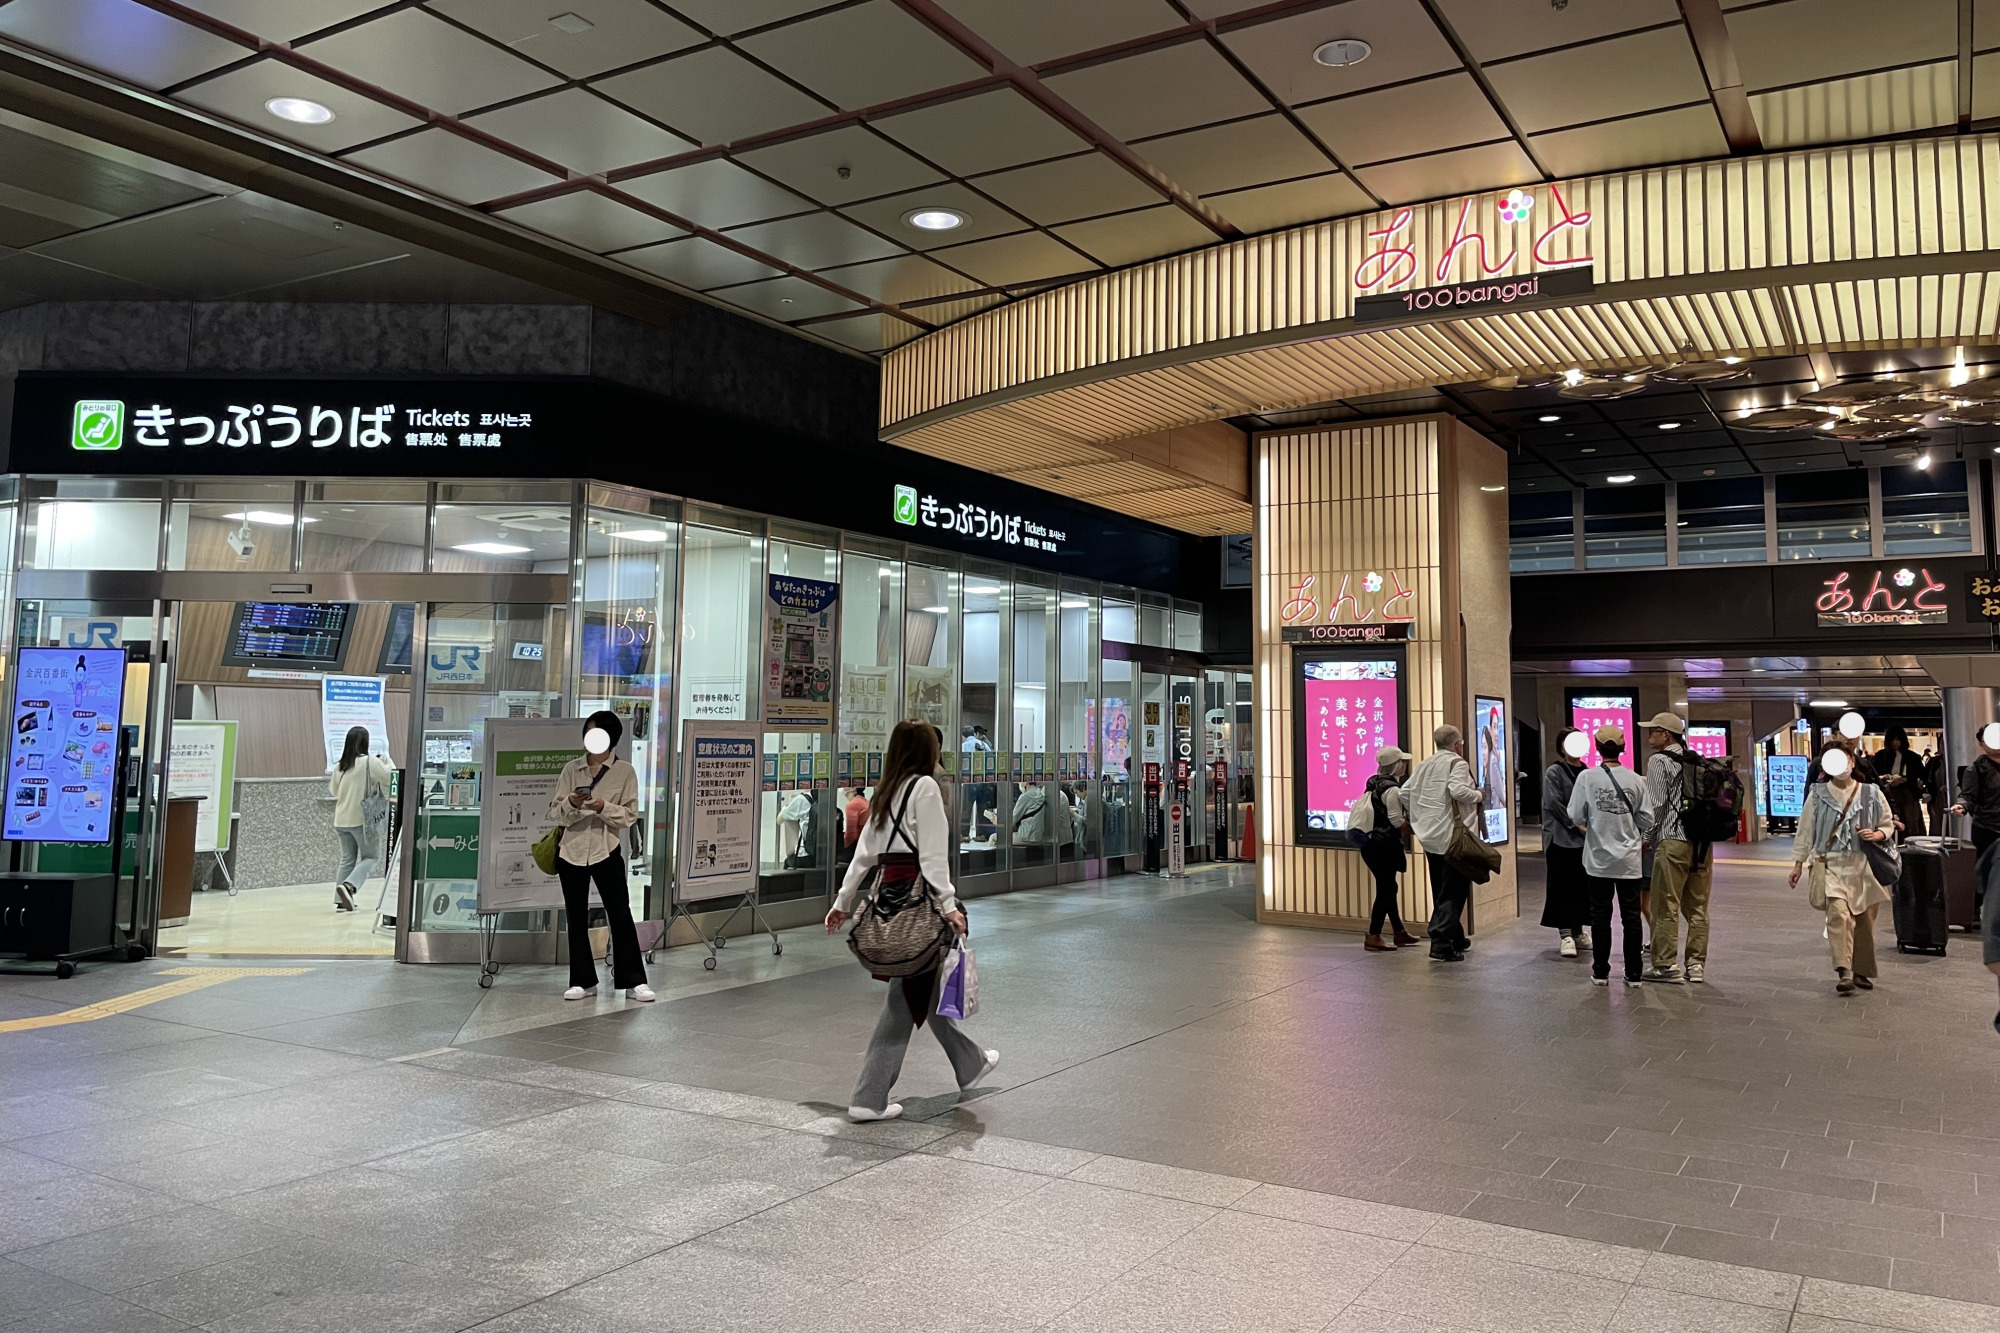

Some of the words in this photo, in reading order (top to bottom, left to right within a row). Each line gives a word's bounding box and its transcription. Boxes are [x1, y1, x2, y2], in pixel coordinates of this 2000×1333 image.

[1355, 184, 1593, 290] あんと
[133, 403, 395, 448] きっぷうりば
[405, 408, 470, 427] Tickets
[479, 413, 532, 427] 표사는곳
[404, 432, 448, 447] 售票处
[457, 432, 502, 447] 售票處
[920, 495, 1022, 545] きっぷうりば
[1024, 521, 1047, 538] Tickets
[1281, 571, 1416, 623] あんと
[1816, 568, 1948, 612] あんと
[431, 645, 480, 671] JR
[25, 668, 69, 678] 金沢百番街
[436, 673, 474, 681] JR西日本
[696, 706, 737, 714] お待ちください
[1355, 697, 1368, 756] おみやげ
[1373, 697, 1384, 752] 金沢が誇
[698, 743, 753, 755] 空席状況のご案内
[515, 762, 566, 770] 整理券システムの
[1149, 765, 1157, 782] 出口
[1172, 823, 1180, 844] 出口
